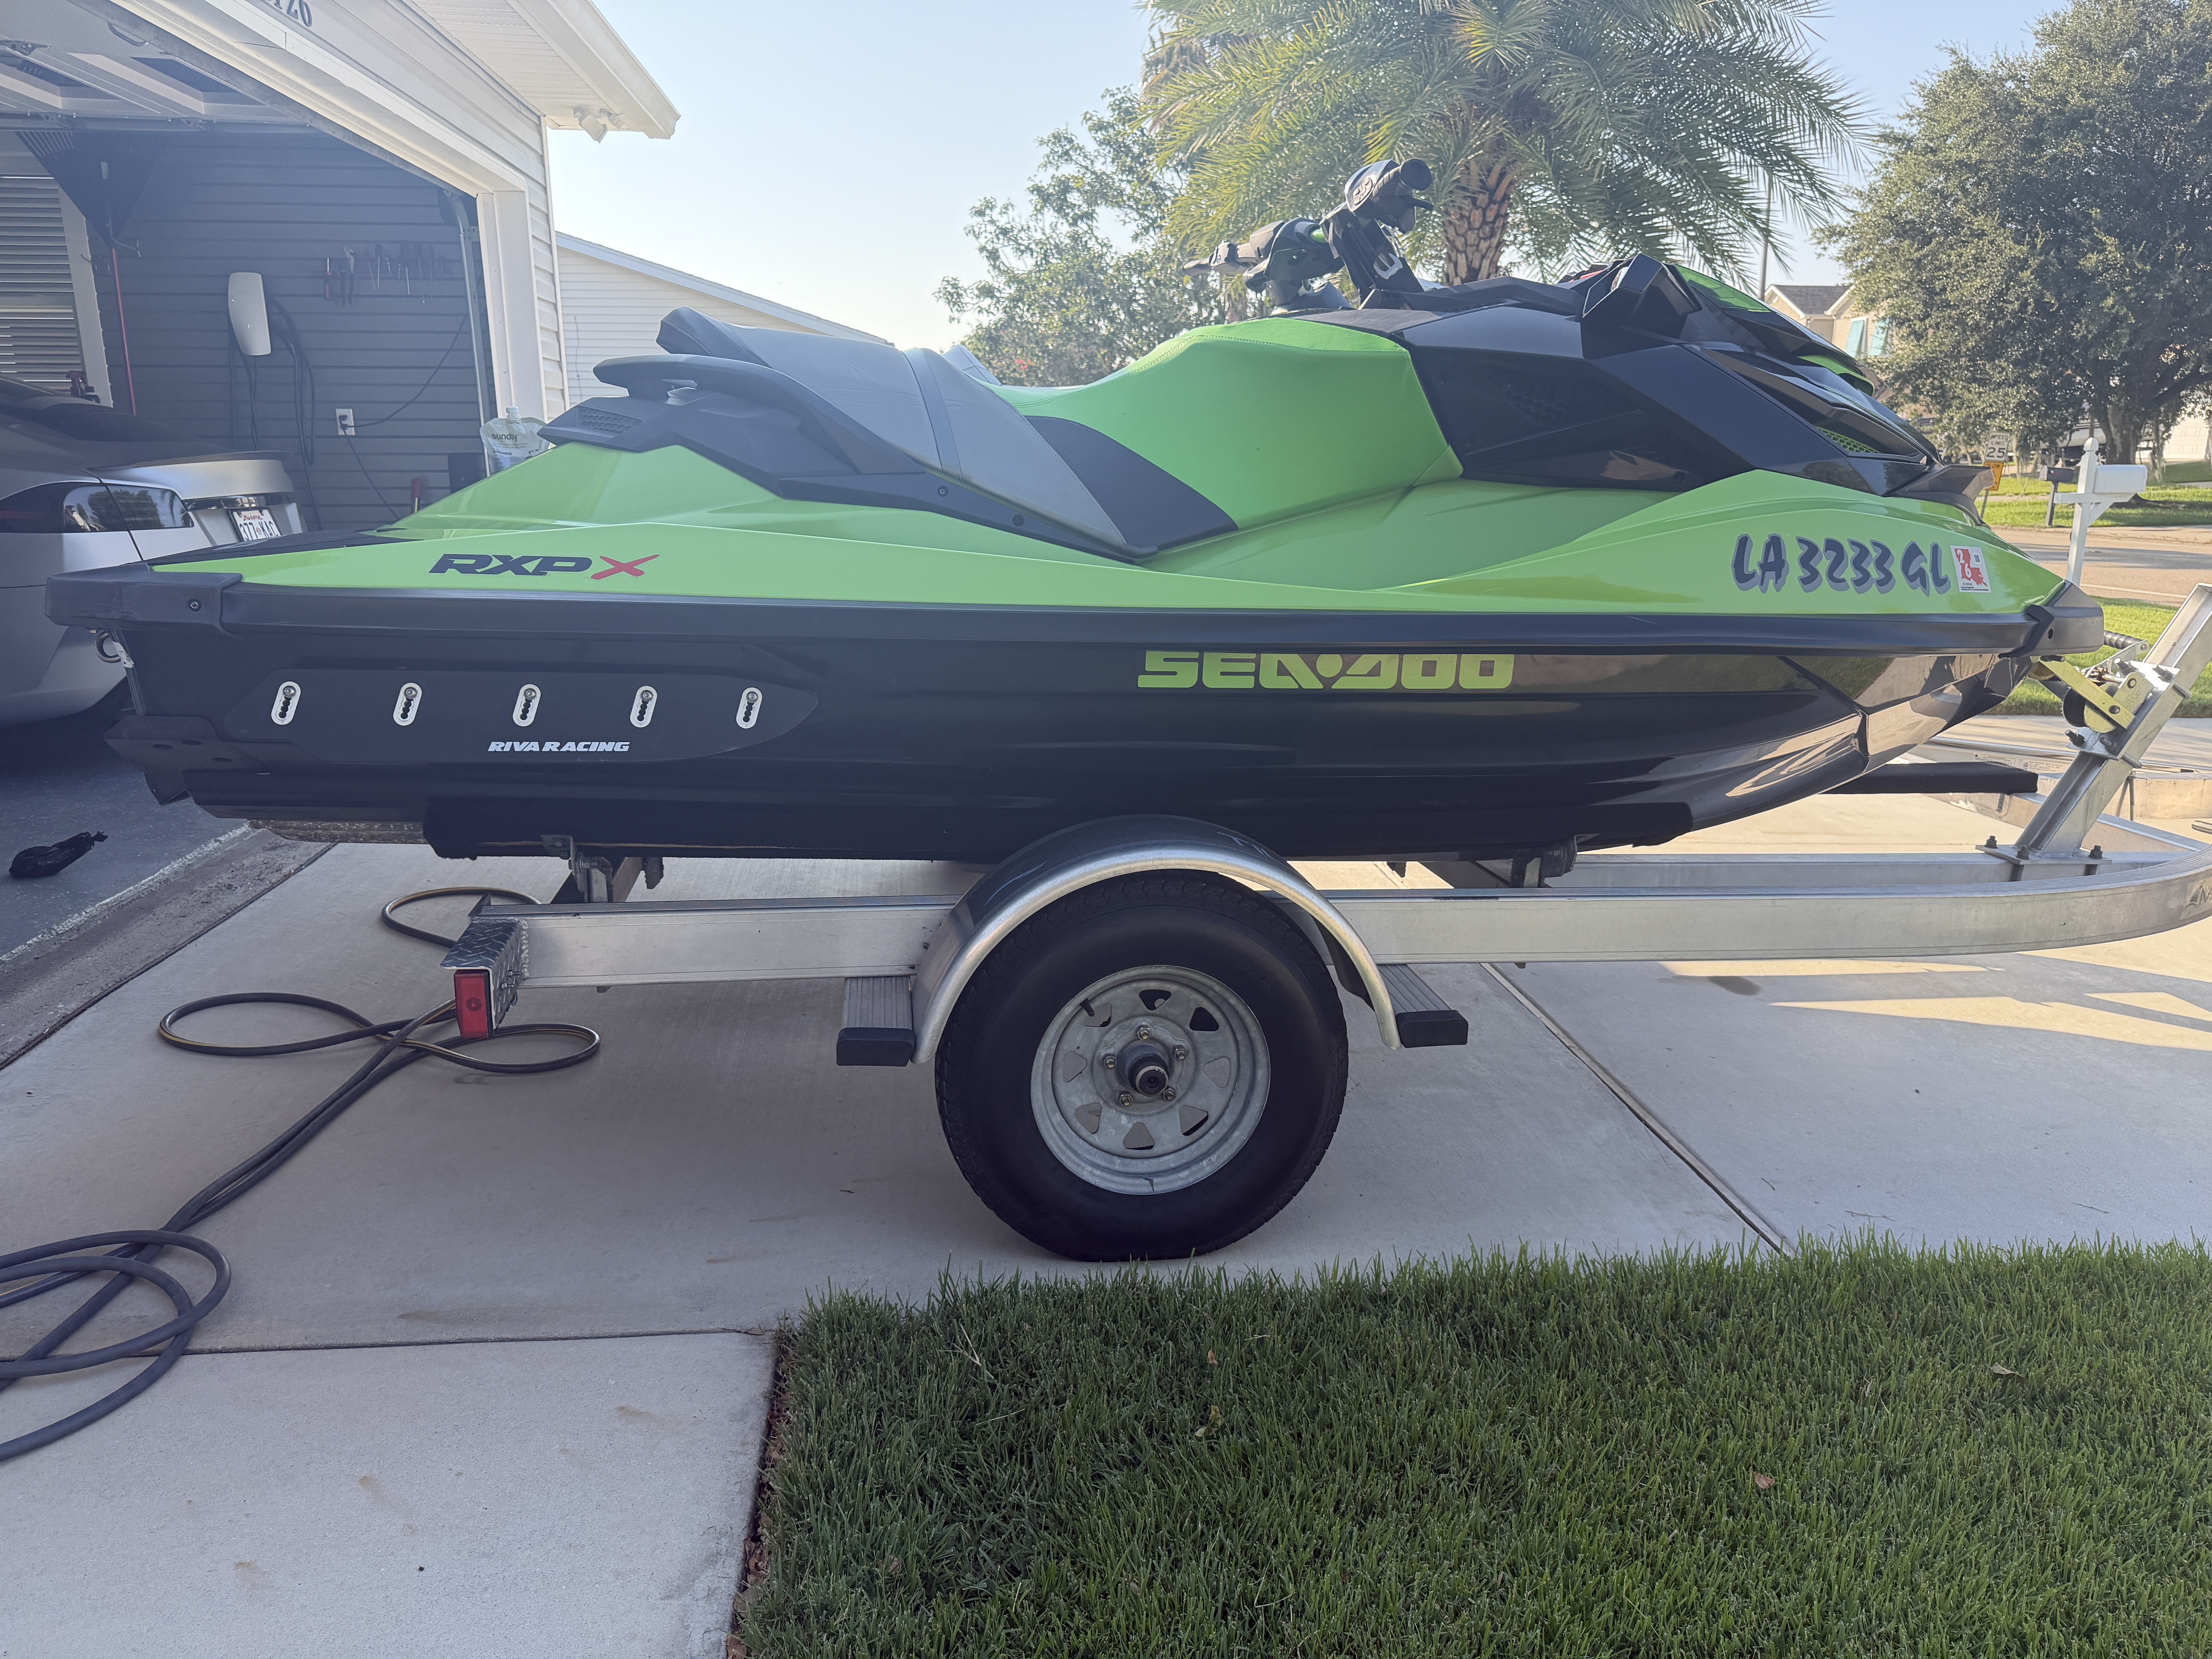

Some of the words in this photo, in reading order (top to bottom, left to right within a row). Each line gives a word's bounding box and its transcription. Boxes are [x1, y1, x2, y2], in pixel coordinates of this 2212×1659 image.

[492, 433, 517, 441] sunday
[1987, 447, 2006, 458] 25
[239, 522, 258, 541] 377
[1731, 533, 1789, 594] LA
[1795, 536, 1896, 594] 3233
[1900, 540, 1951, 597] GL
[488, 741, 540, 752] RIVA
[542, 741, 630, 752] RACING
